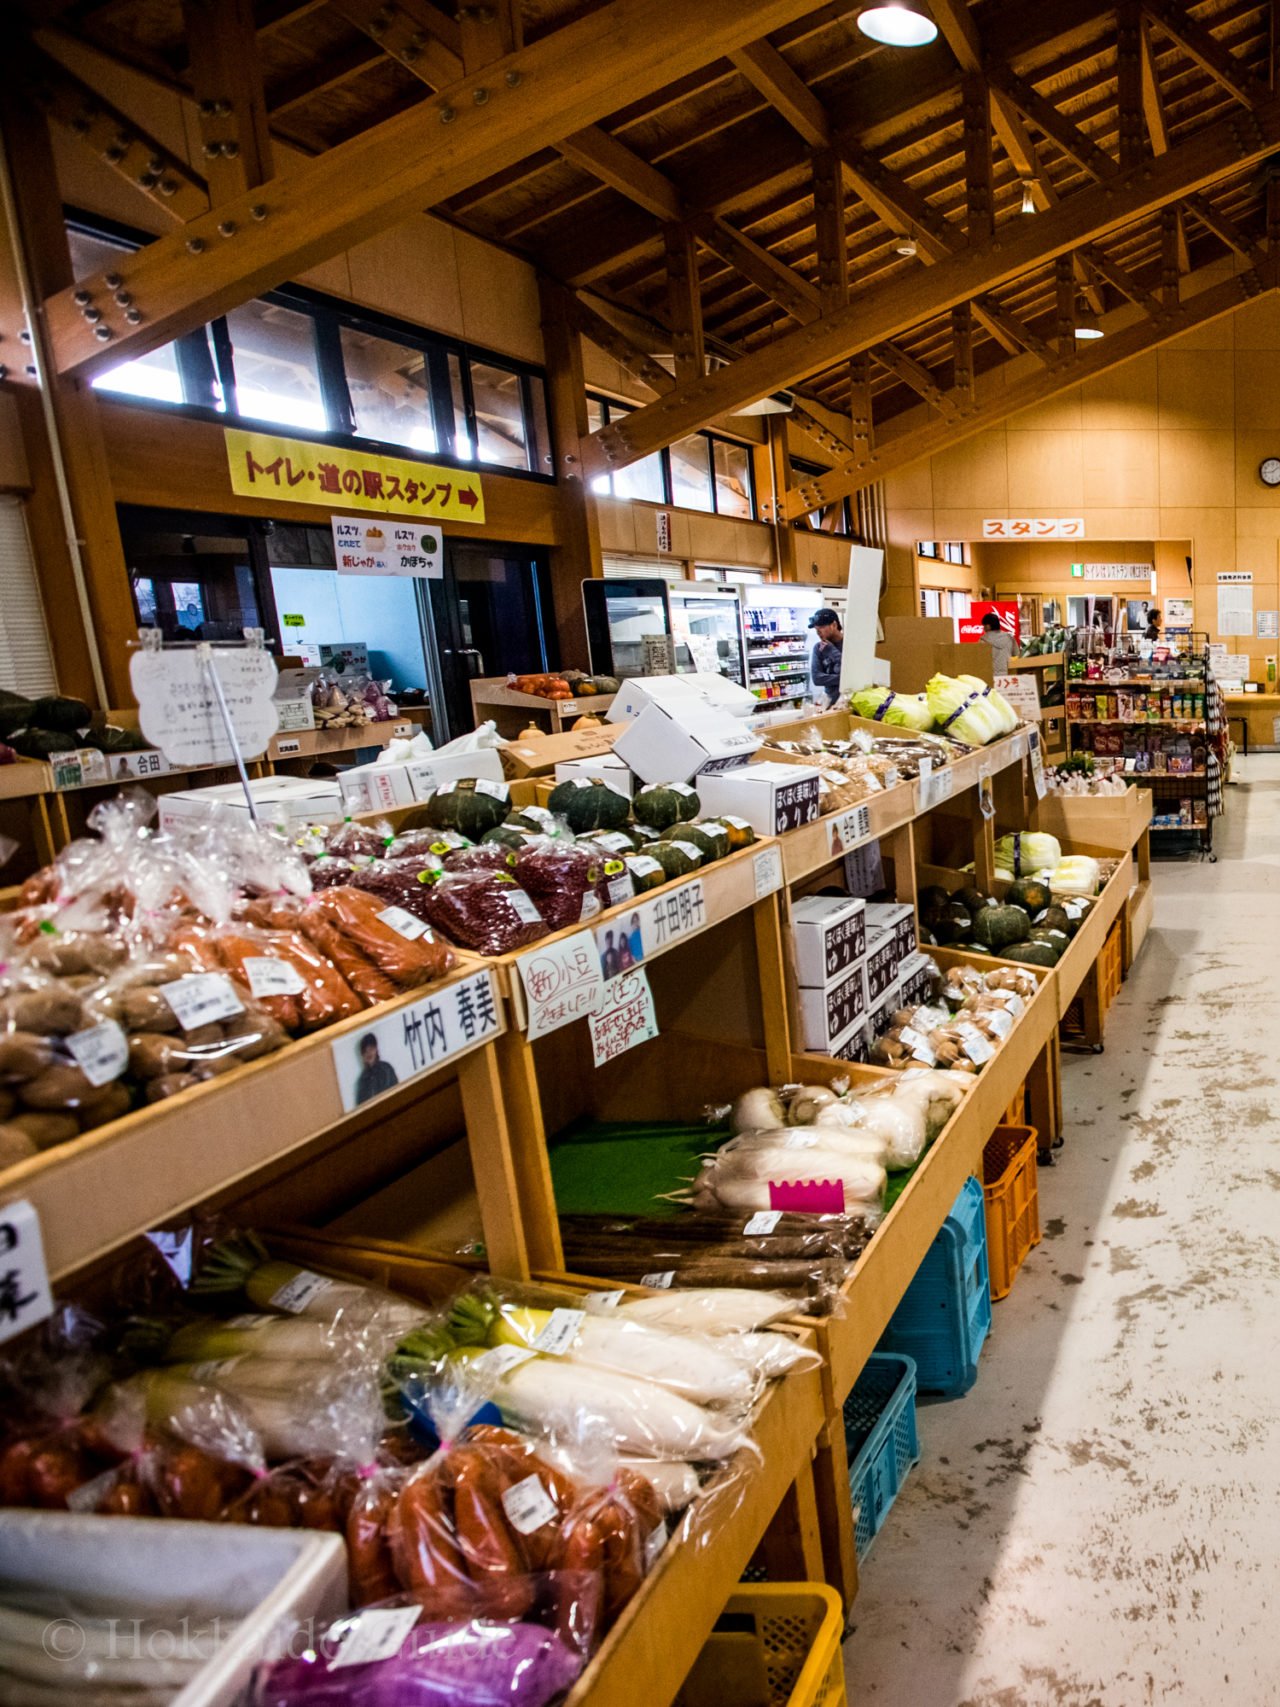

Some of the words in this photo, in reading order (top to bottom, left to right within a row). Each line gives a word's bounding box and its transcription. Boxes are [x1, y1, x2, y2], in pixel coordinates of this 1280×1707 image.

[246, 451, 452, 507] トイレ・道の駅スタンプ
[337, 525, 359, 536] ルスツ
[395, 530, 415, 541] ルスツ
[985, 519, 1081, 536] スタンプ
[342, 555, 375, 568] 新じゃが
[401, 556, 434, 569] かぼちゃ
[776, 780, 820, 809] ほくほく美味しい
[827, 909, 866, 950] ほくほく美味しい
[827, 934, 866, 973] ゆりね
[403, 1003, 448, 1072] 竹内
[455, 975, 498, 1043] 春美
[829, 993, 864, 1035] ゆりね
